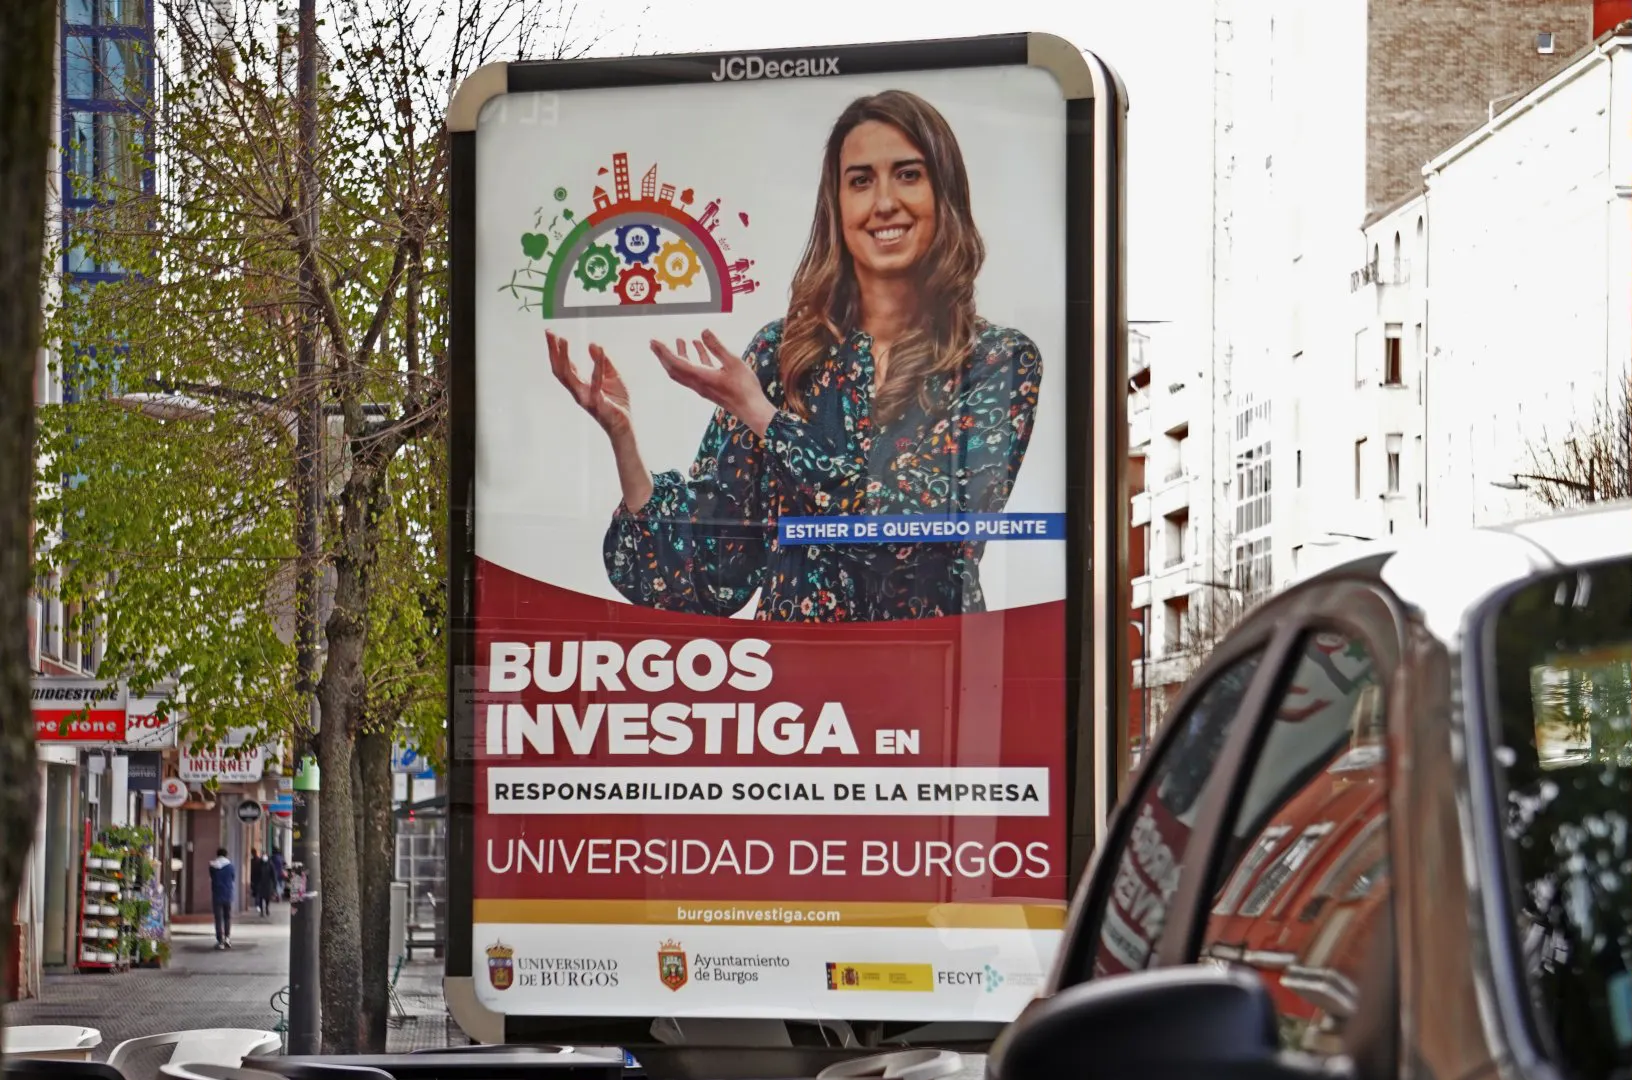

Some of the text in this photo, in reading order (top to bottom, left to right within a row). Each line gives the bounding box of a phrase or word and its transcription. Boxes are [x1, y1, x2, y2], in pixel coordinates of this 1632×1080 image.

[711, 56, 840, 82] JCDecaux
[785, 519, 1047, 539] ESTHER DE QUEVEDO PUENTE
[489, 639, 772, 692] BURGOS
[32, 687, 118, 701] RIDGESTOE
[36, 720, 117, 732] retone
[486, 702, 920, 755] INVESTIGA EN
[189, 760, 251, 772] INTERNET
[495, 782, 1039, 802] RESPONSABILIDAD SOCIAL DE LA EMPRESA
[488, 839, 1049, 878] UNIVERSIDAD DE BURGOS
[677, 906, 841, 923] burgosinvestiga.com
[518, 957, 618, 971] UNIVERSIDAD
[693, 953, 790, 970] Ayuntamiento
[519, 971, 619, 987] DE BURGOS
[694, 967, 759, 985] de Burgos
[937, 971, 983, 985] FECYT
